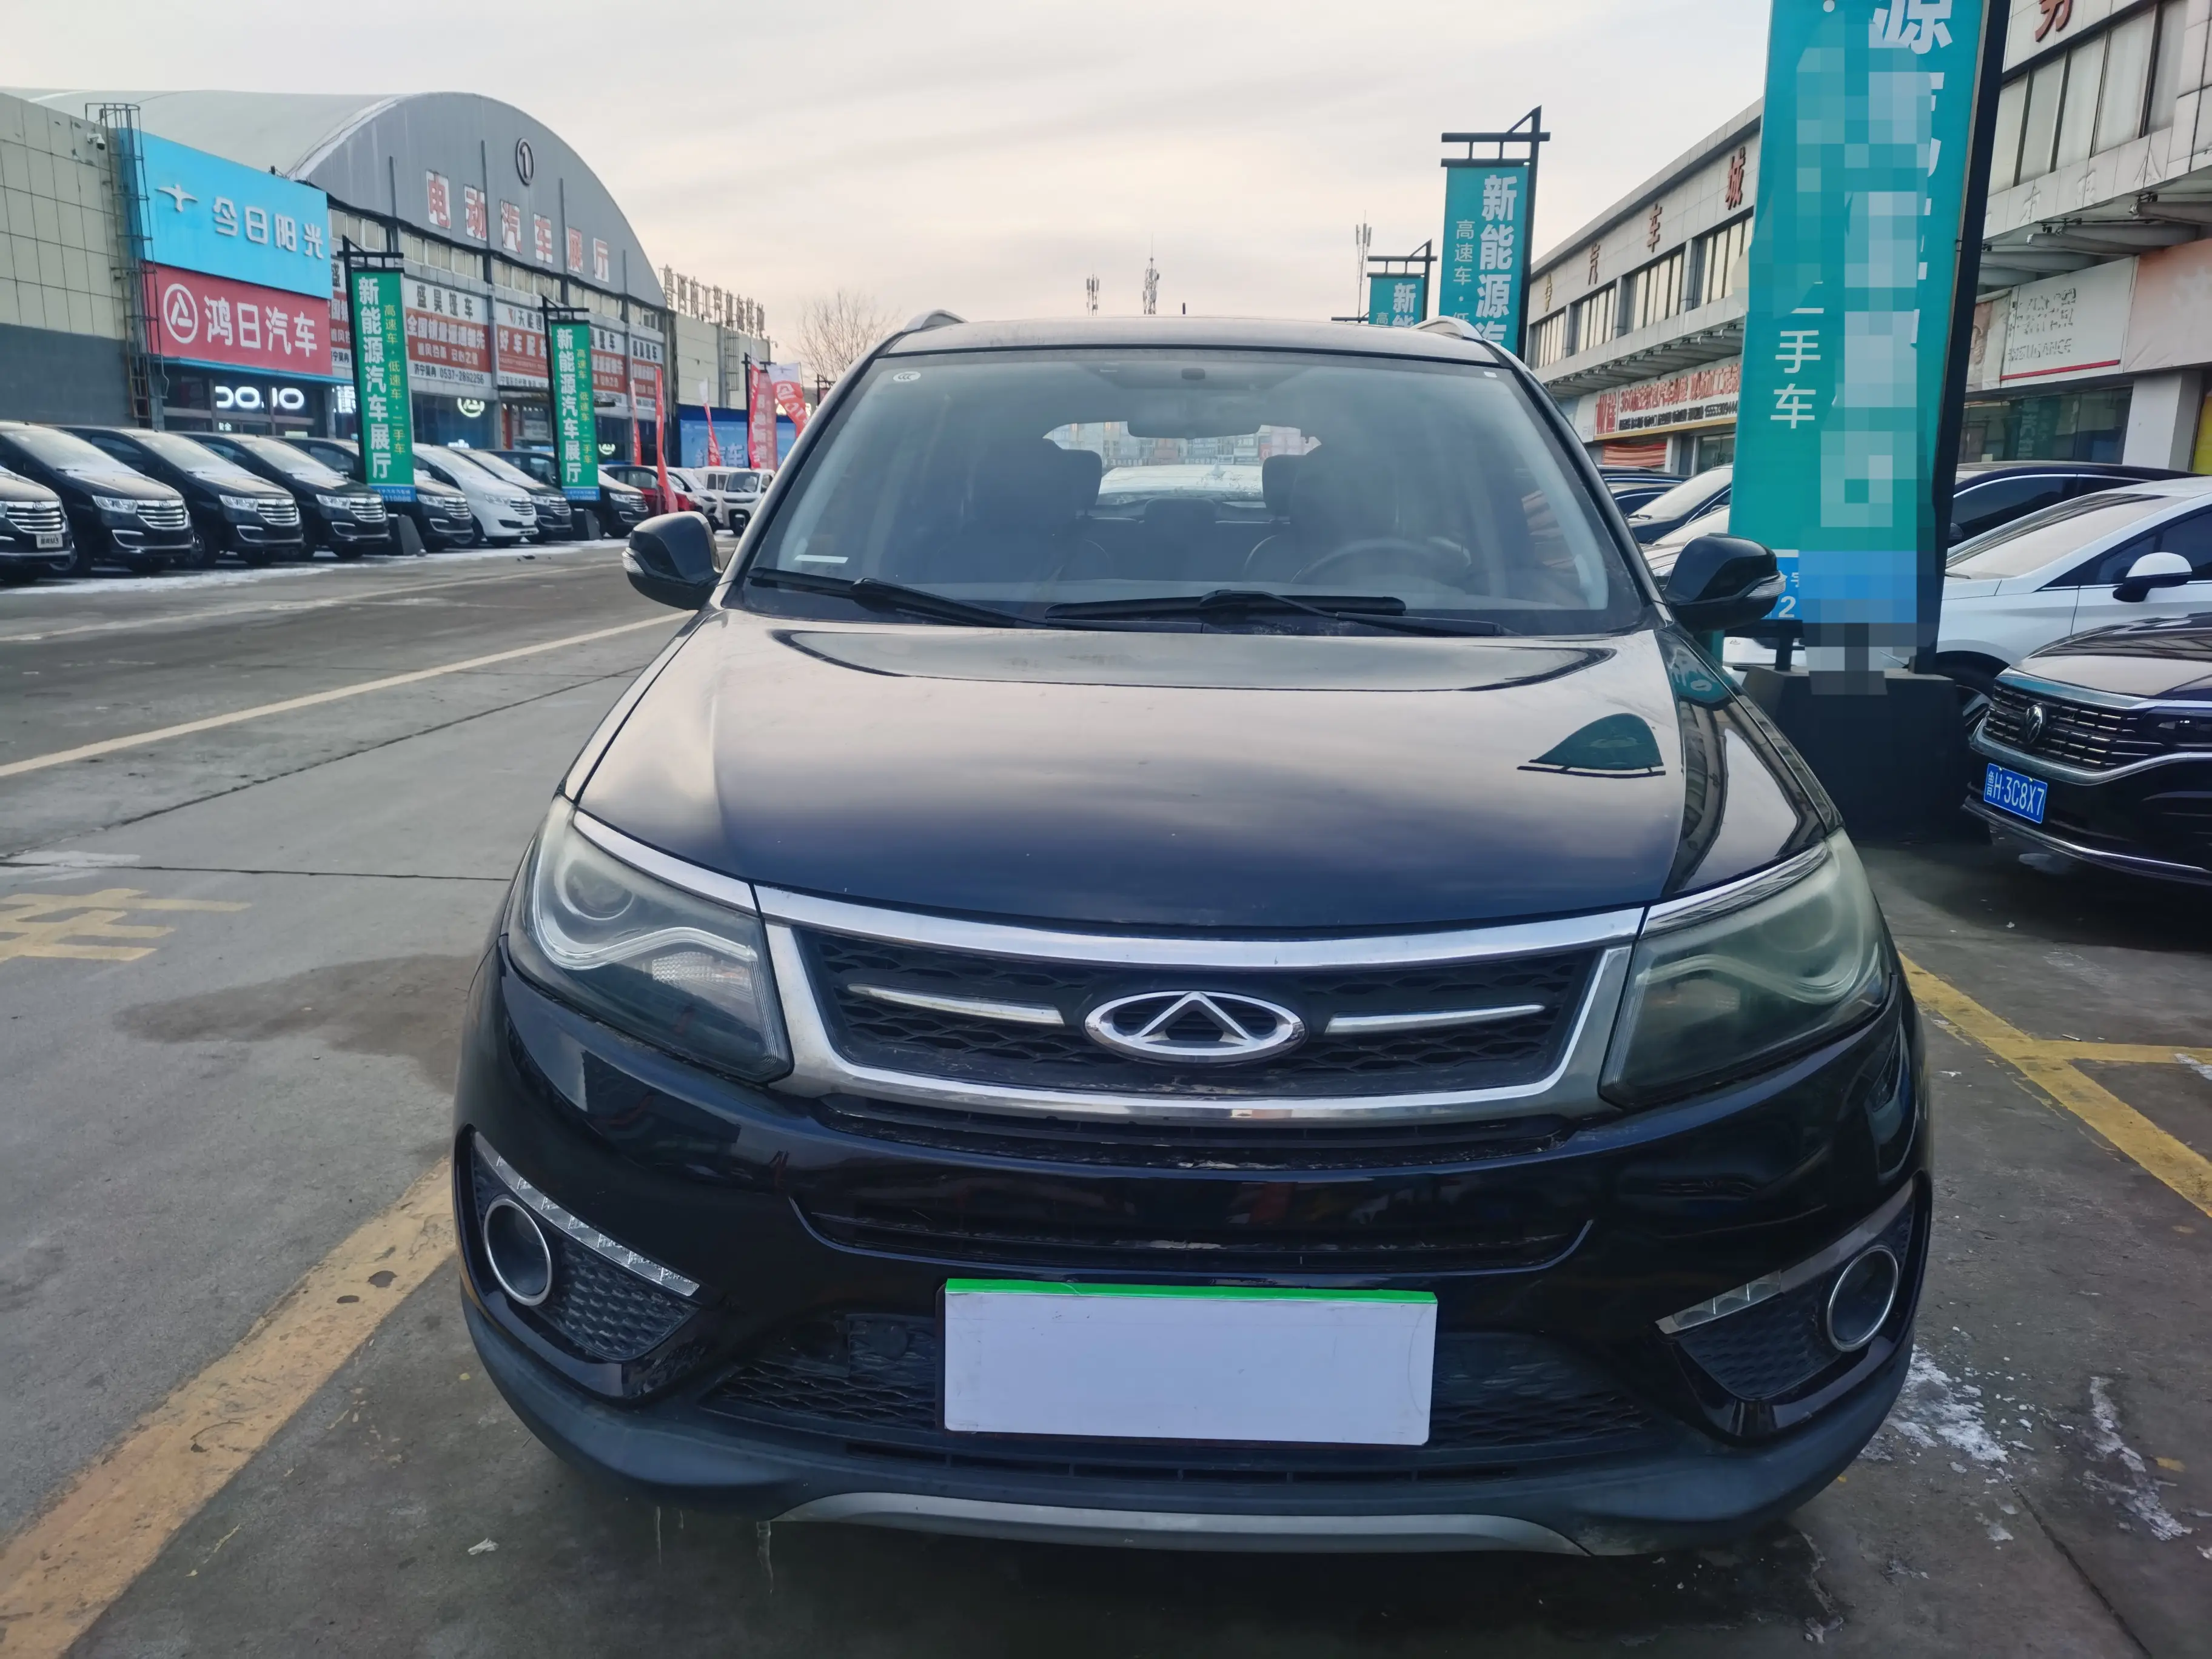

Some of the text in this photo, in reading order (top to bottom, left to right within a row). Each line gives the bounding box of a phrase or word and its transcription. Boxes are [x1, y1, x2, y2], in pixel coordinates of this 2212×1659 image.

[212, 196, 324, 260] 今日阳光
[204, 295, 318, 357] 鸿日汽车
[358, 276, 393, 478] 新能源汽车展厅
[557, 327, 582, 483] 新能源汽车展厅
[1986, 770, 2045, 816] 鲁H·3C8X7
